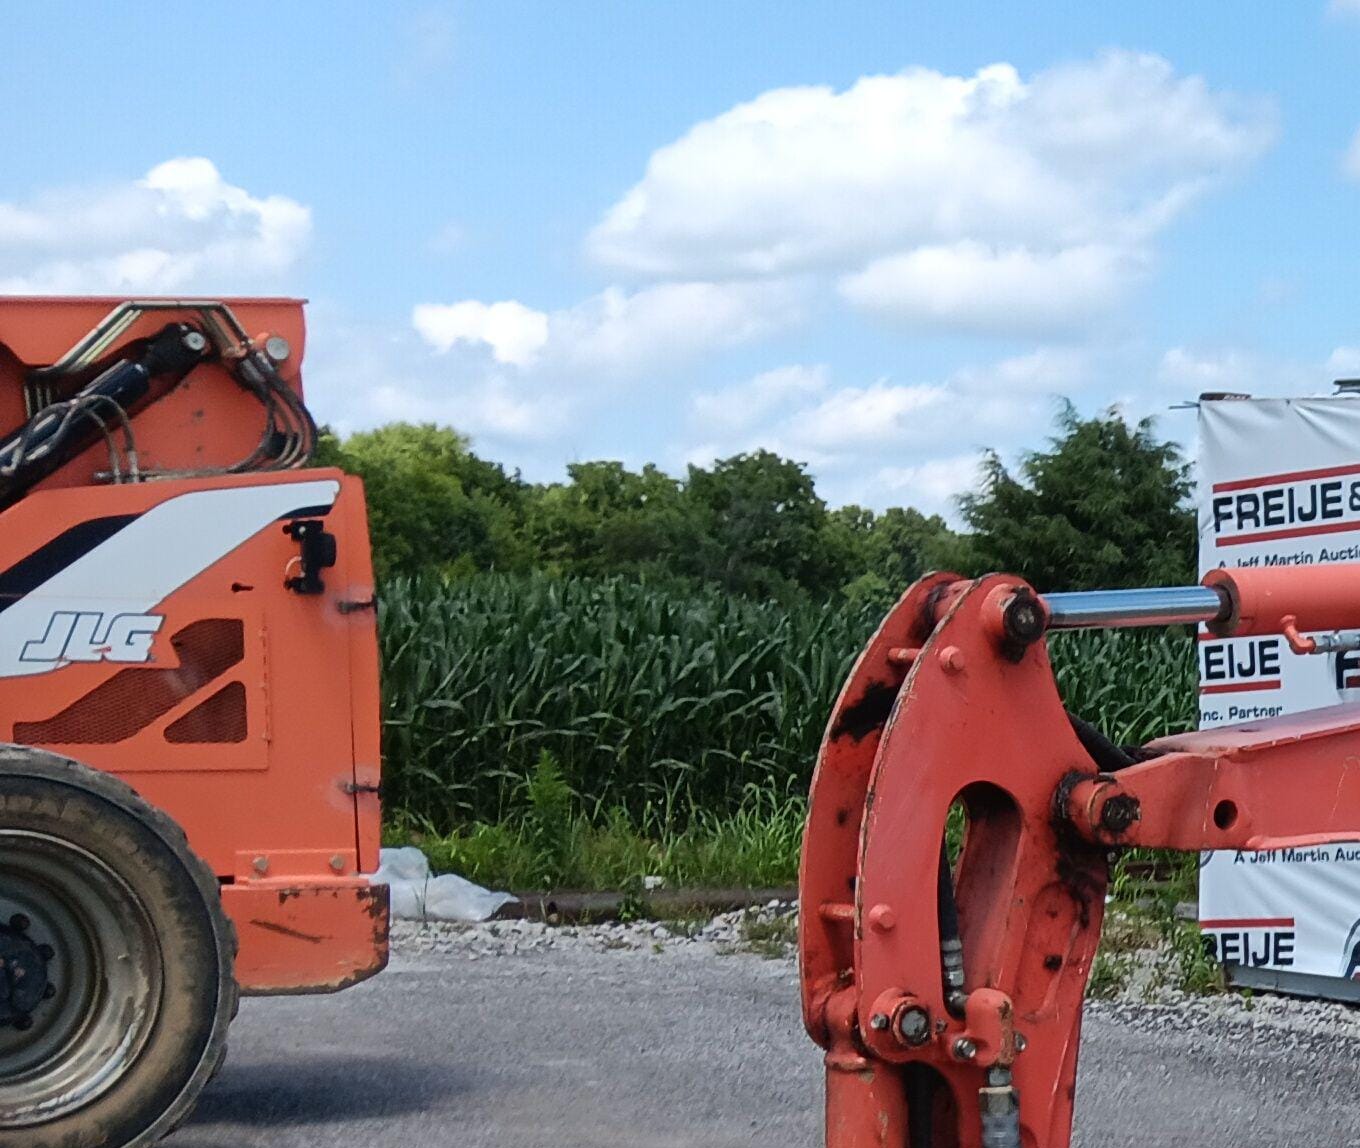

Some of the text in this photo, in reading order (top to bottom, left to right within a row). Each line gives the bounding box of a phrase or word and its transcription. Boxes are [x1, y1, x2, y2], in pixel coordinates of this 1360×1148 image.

[1212, 481, 1344, 534] FREIJE
[1265, 551, 1313, 567] Martin
[20, 611, 166, 662] JLG
[1200, 640, 1281, 681] EIJE
[1228, 705, 1283, 720] Partner
[1234, 851, 1245, 864] A
[1250, 850, 1276, 863] Jeff
[1282, 848, 1329, 863] Martin
